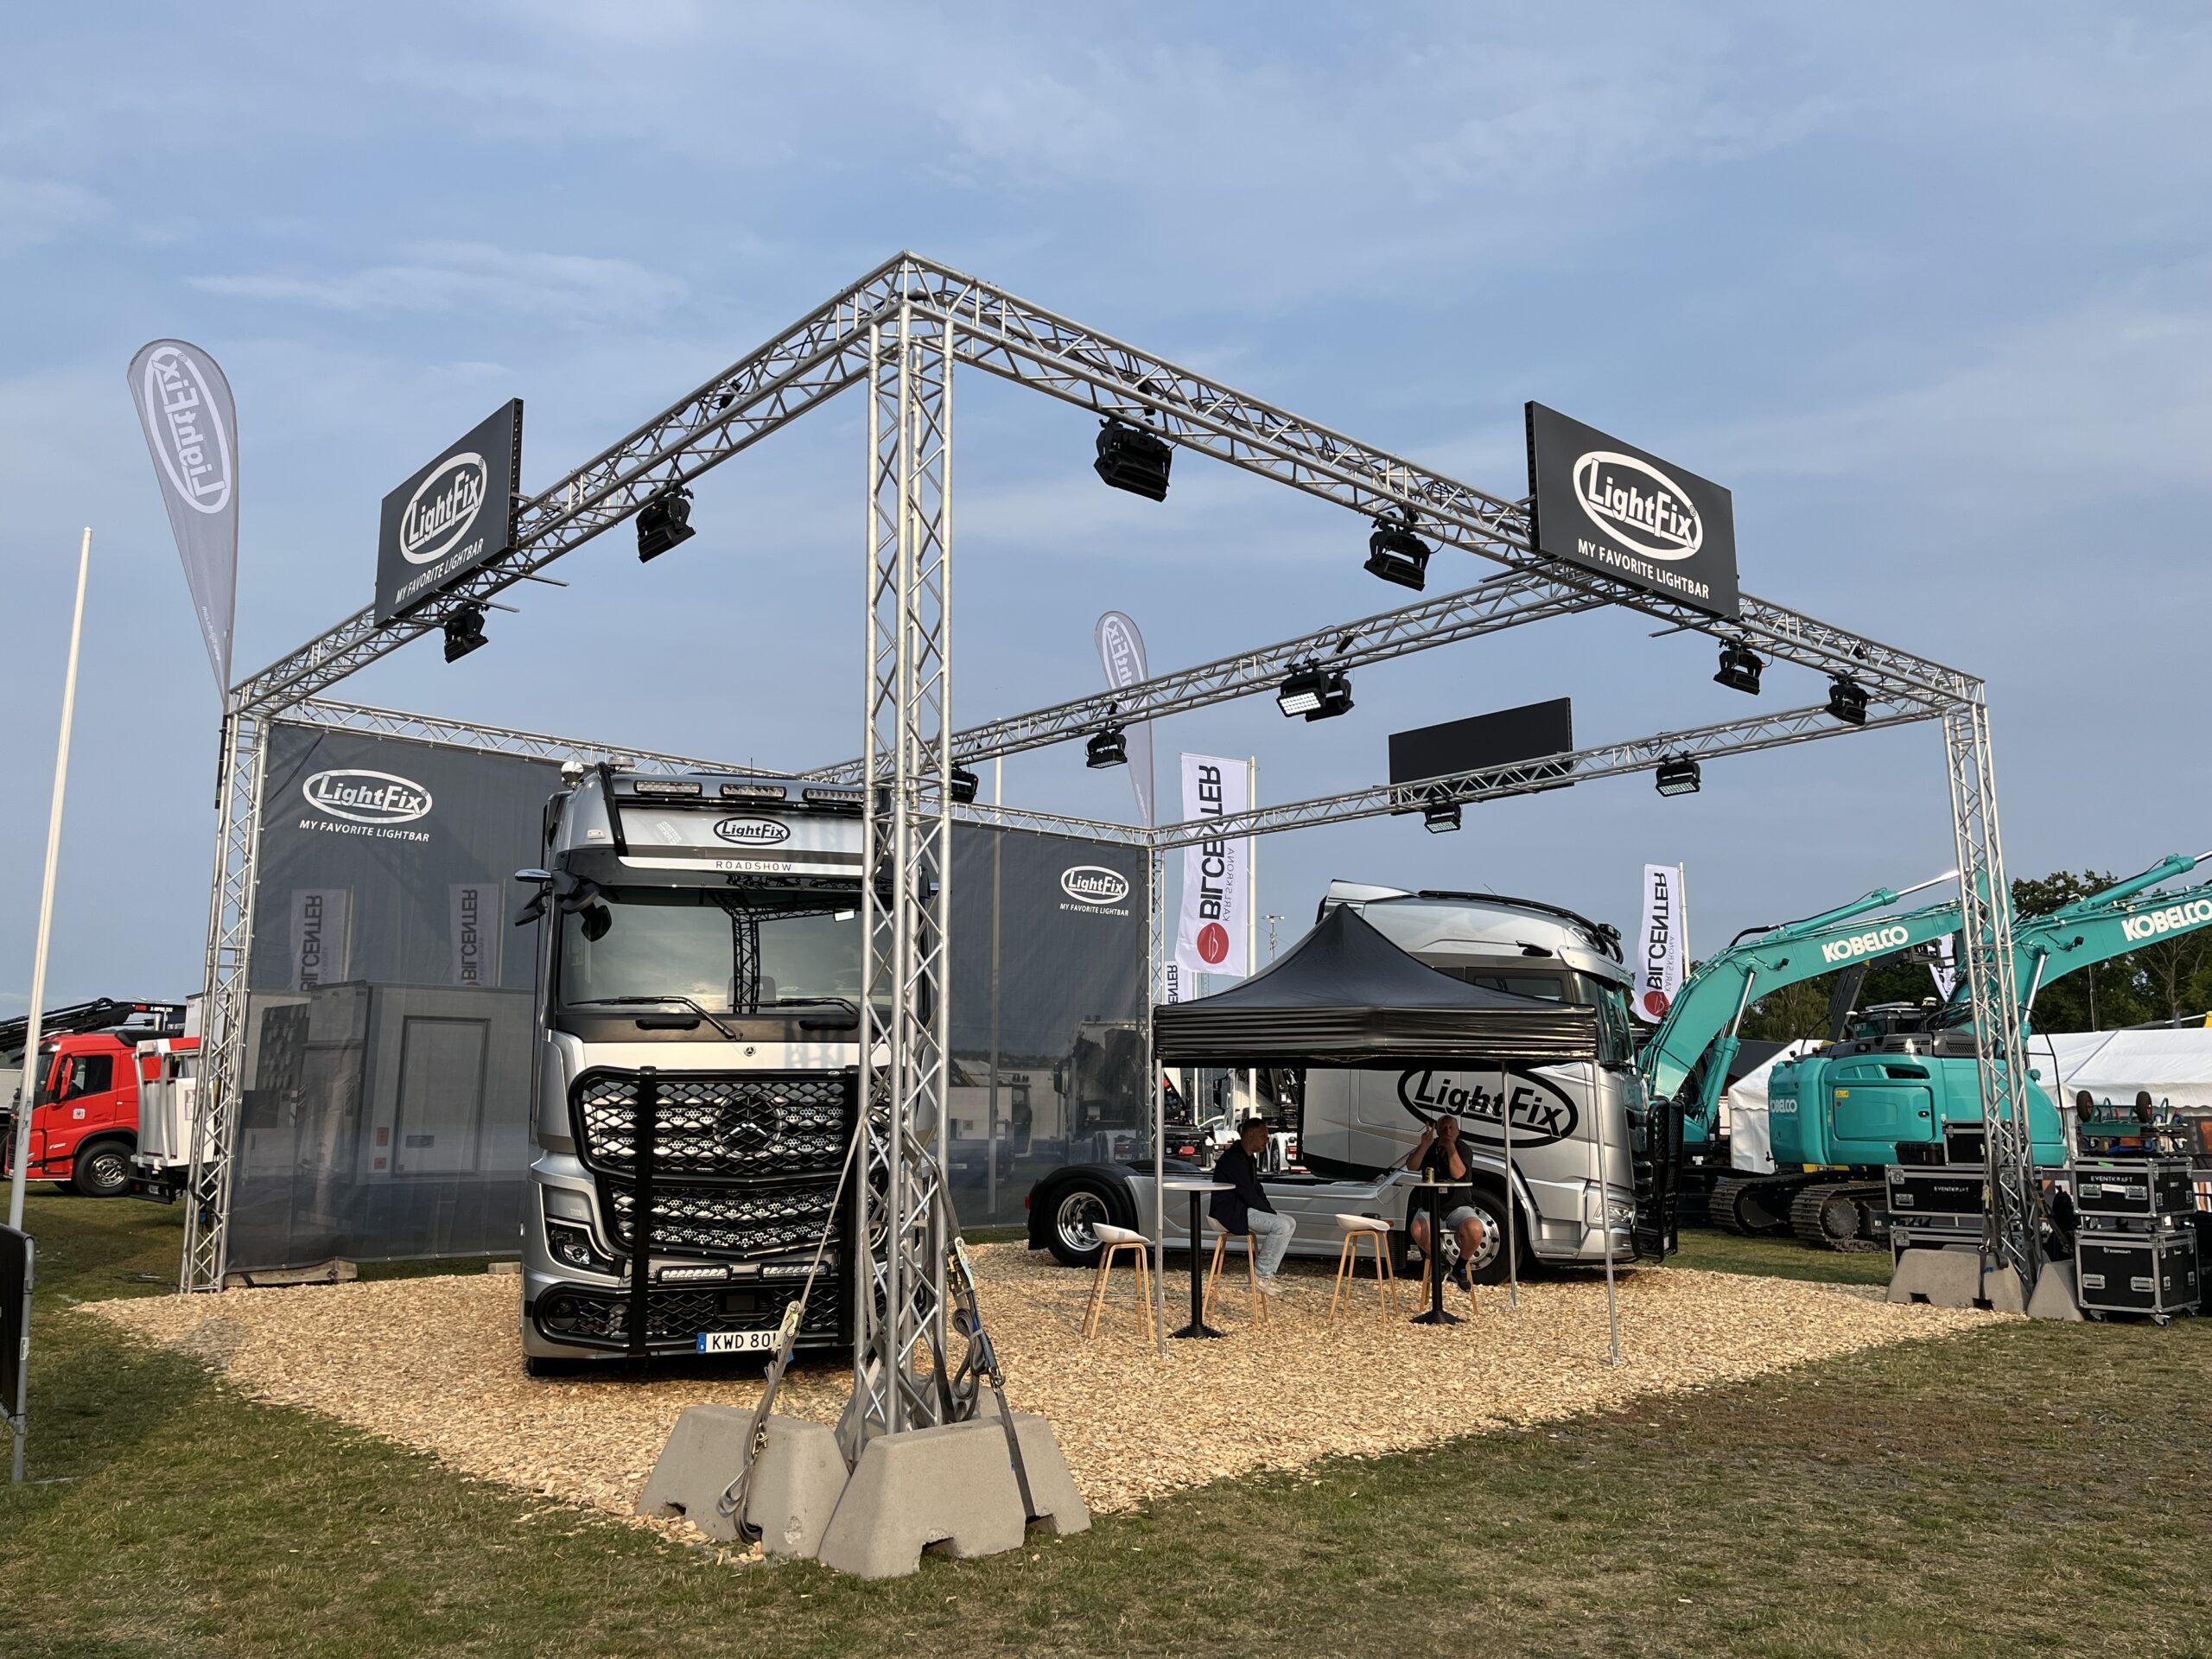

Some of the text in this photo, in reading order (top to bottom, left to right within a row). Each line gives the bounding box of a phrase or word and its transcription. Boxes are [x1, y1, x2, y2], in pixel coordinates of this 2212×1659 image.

[408, 470, 481, 550] LightFix
[1587, 458, 1695, 550] LightFix
[396, 538, 484, 604] MY FAVORITE LIGHTBAR
[1578, 538, 1710, 599] MY FAVORITE LIGHTBAR
[315, 774, 423, 815] LightFix
[299, 819, 430, 842] MY FAVORITE LIGHTBAR
[721, 821, 786, 840] LightFix
[715, 861, 792, 872] ROADSHOW
[1068, 869, 1123, 896] LightFix
[1070, 904, 1099, 913] FAVORITE
[1099, 907, 1129, 917] LIGHTBAR
[2120, 899, 2212, 942] KOBELCO
[1821, 925, 1909, 963] KOBELCO
[1412, 1070, 1564, 1138] LightFix
[1770, 1098, 1797, 1113] OBELCO
[712, 1334, 745, 1351] KWD
